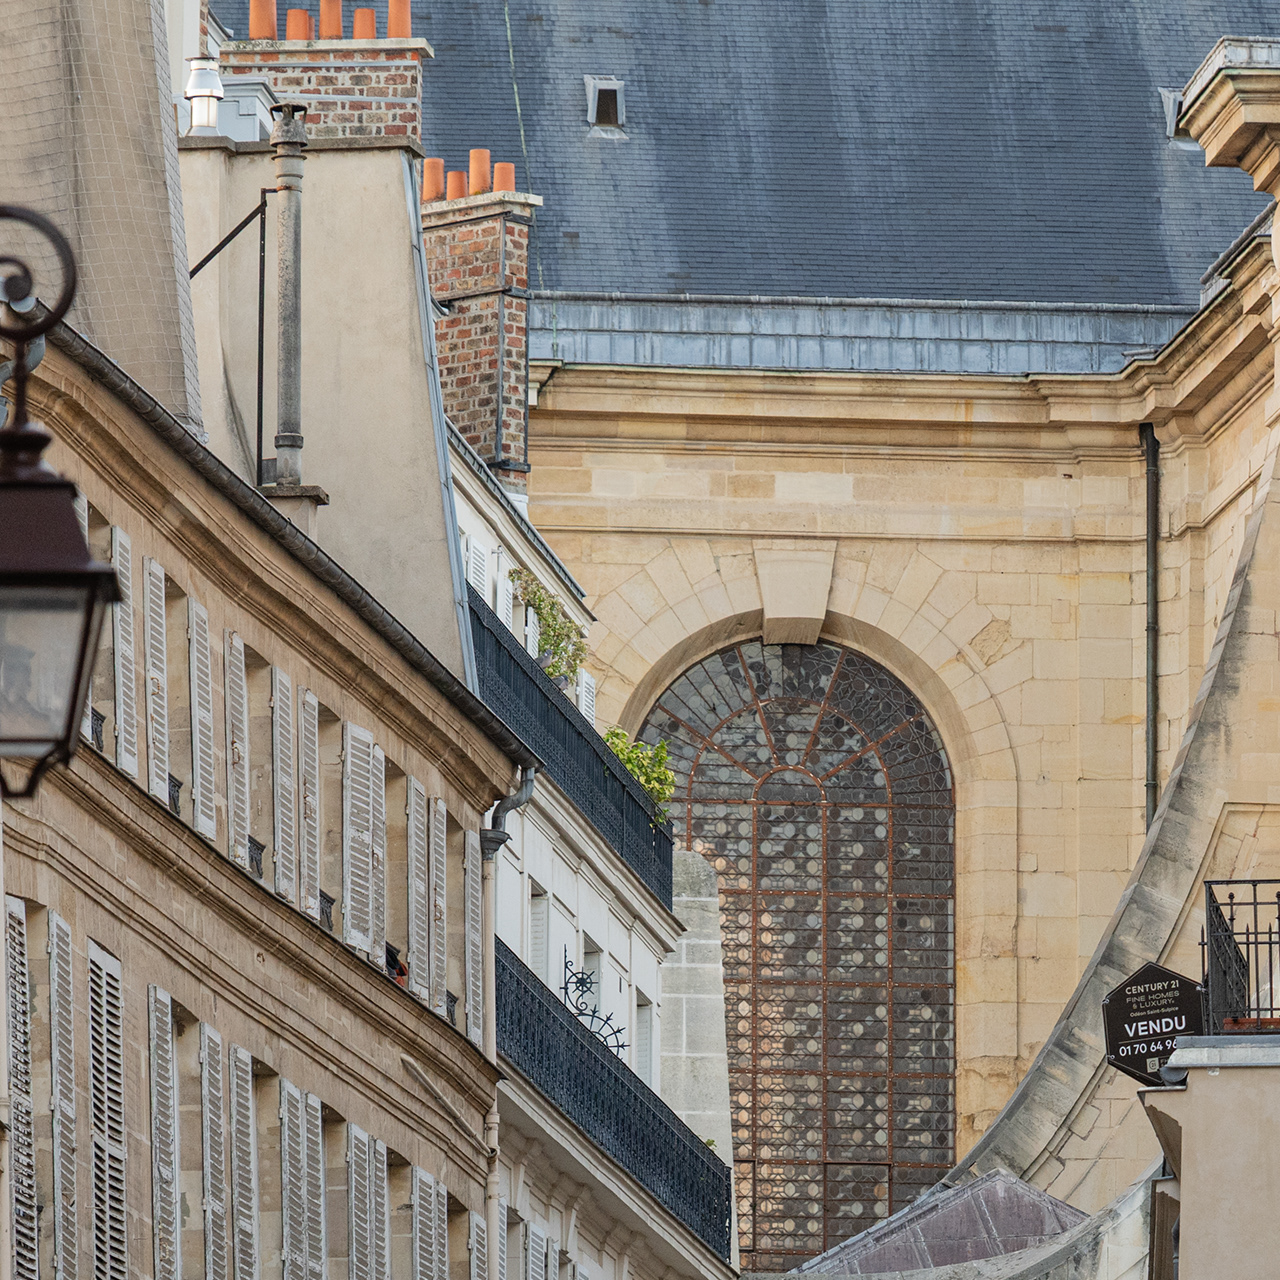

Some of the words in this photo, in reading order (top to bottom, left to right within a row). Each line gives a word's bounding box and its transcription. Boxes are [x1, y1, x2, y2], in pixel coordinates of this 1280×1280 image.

[1125, 981, 1169, 995] CENTURY
[1170, 980, 1179, 988] 21
[1126, 995, 1146, 1003] FINE
[1148, 990, 1179, 1000] HOMES
[1124, 1015, 1186, 1037] VENDU
[1119, 1045, 1132, 1056] 01
[1133, 1043, 1147, 1055] 70
[1150, 1041, 1163, 1052] 64
